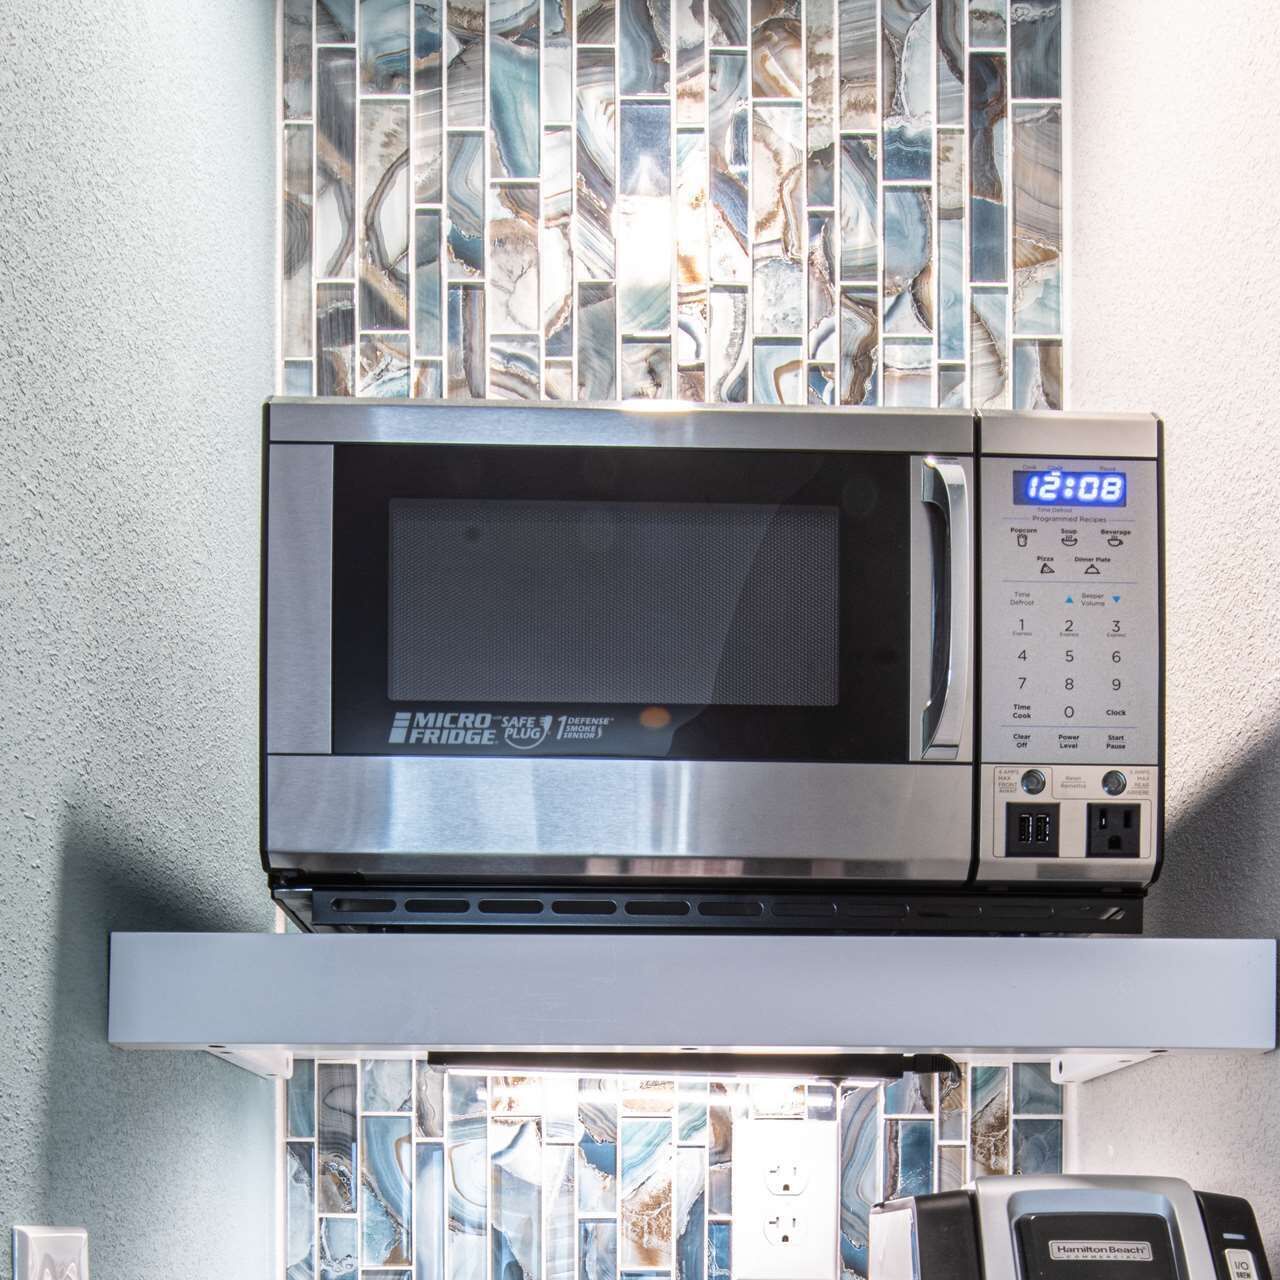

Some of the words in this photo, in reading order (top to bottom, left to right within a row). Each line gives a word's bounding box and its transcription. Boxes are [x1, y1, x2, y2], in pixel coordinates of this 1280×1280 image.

[1028, 476, 1122, 500] 12:08
[1032, 515, 1078, 523] Programmed
[1080, 516, 1107, 524] Recipes
[1081, 592, 1104, 600] Beeper
[1019, 619, 1024, 631] 1
[1065, 620, 1074, 632] 2
[1112, 620, 1121, 633] 3
[1017, 650, 1027, 662] 4
[1065, 650, 1074, 662] 5
[1112, 651, 1121, 663] 6
[1018, 677, 1027, 689] 7
[1065, 678, 1074, 690] 8
[1112, 678, 1121, 691] 9
[1064, 706, 1074, 718] 0
[413, 712, 492, 728] MICRO
[501, 716, 536, 727] SAFE
[568, 717, 609, 725] DEFENSE
[409, 729, 496, 744] FRIDGE
[504, 728, 540, 739] PLUG
[1108, 1246, 1144, 1254] Beach
